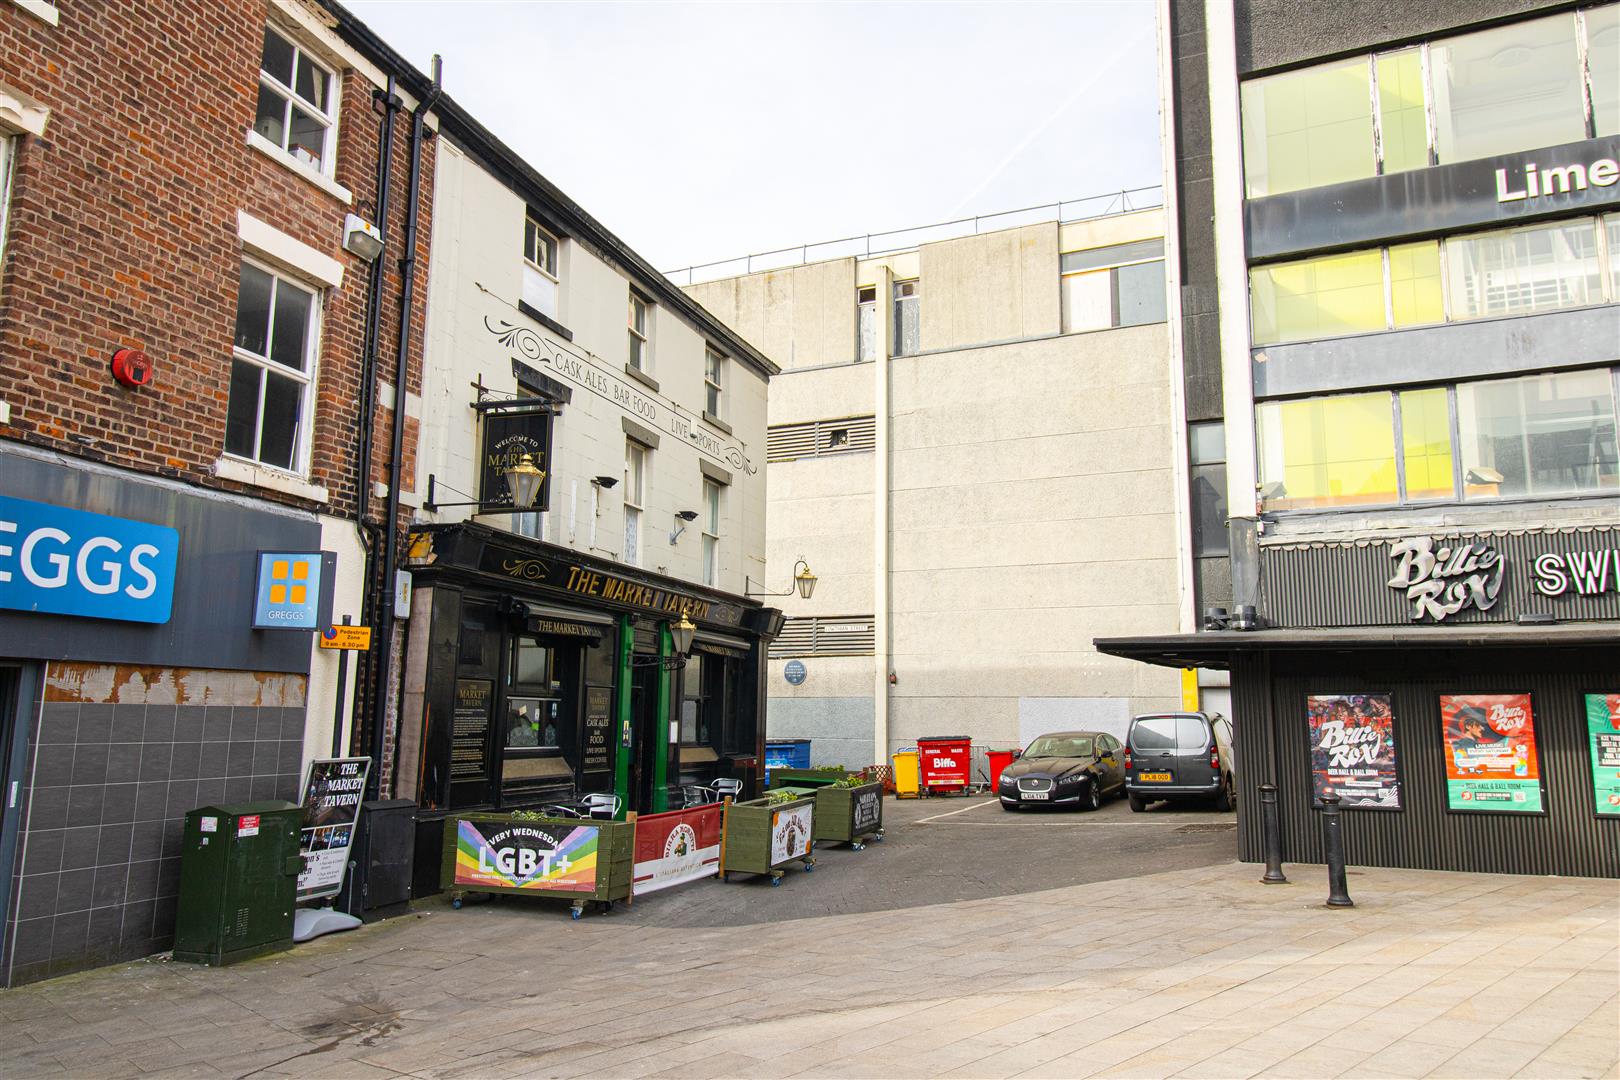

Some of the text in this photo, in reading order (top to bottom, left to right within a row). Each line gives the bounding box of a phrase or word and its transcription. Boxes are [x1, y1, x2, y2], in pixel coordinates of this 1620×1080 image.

[1495, 158, 1620, 203] Lime
[555, 353, 582, 381] CASK
[584, 369, 608, 394] ALES
[614, 384, 630, 407] BAR
[633, 395, 656, 420] FOOD
[671, 418, 688, 439] LIVE
[495, 435, 539, 450] WELCOME TO
[1388, 536, 1503, 589] Billie
[566, 566, 711, 618] THE MARKET TAVERN
[268, 610, 305, 620] GREGGS
[538, 620, 553, 632] THE
[553, 622, 579, 635] MARKET
[590, 735, 604, 744] FOOD
[1319, 720, 1380, 749] Billie
[340, 763, 359, 775] THE
[933, 757, 957, 768] Biffa
[327, 777, 364, 791] MARKET
[324, 793, 359, 807] TAVERN
[486, 827, 565, 852] EVERY WEDNESDAY
[479, 846, 573, 876] LGBT+
